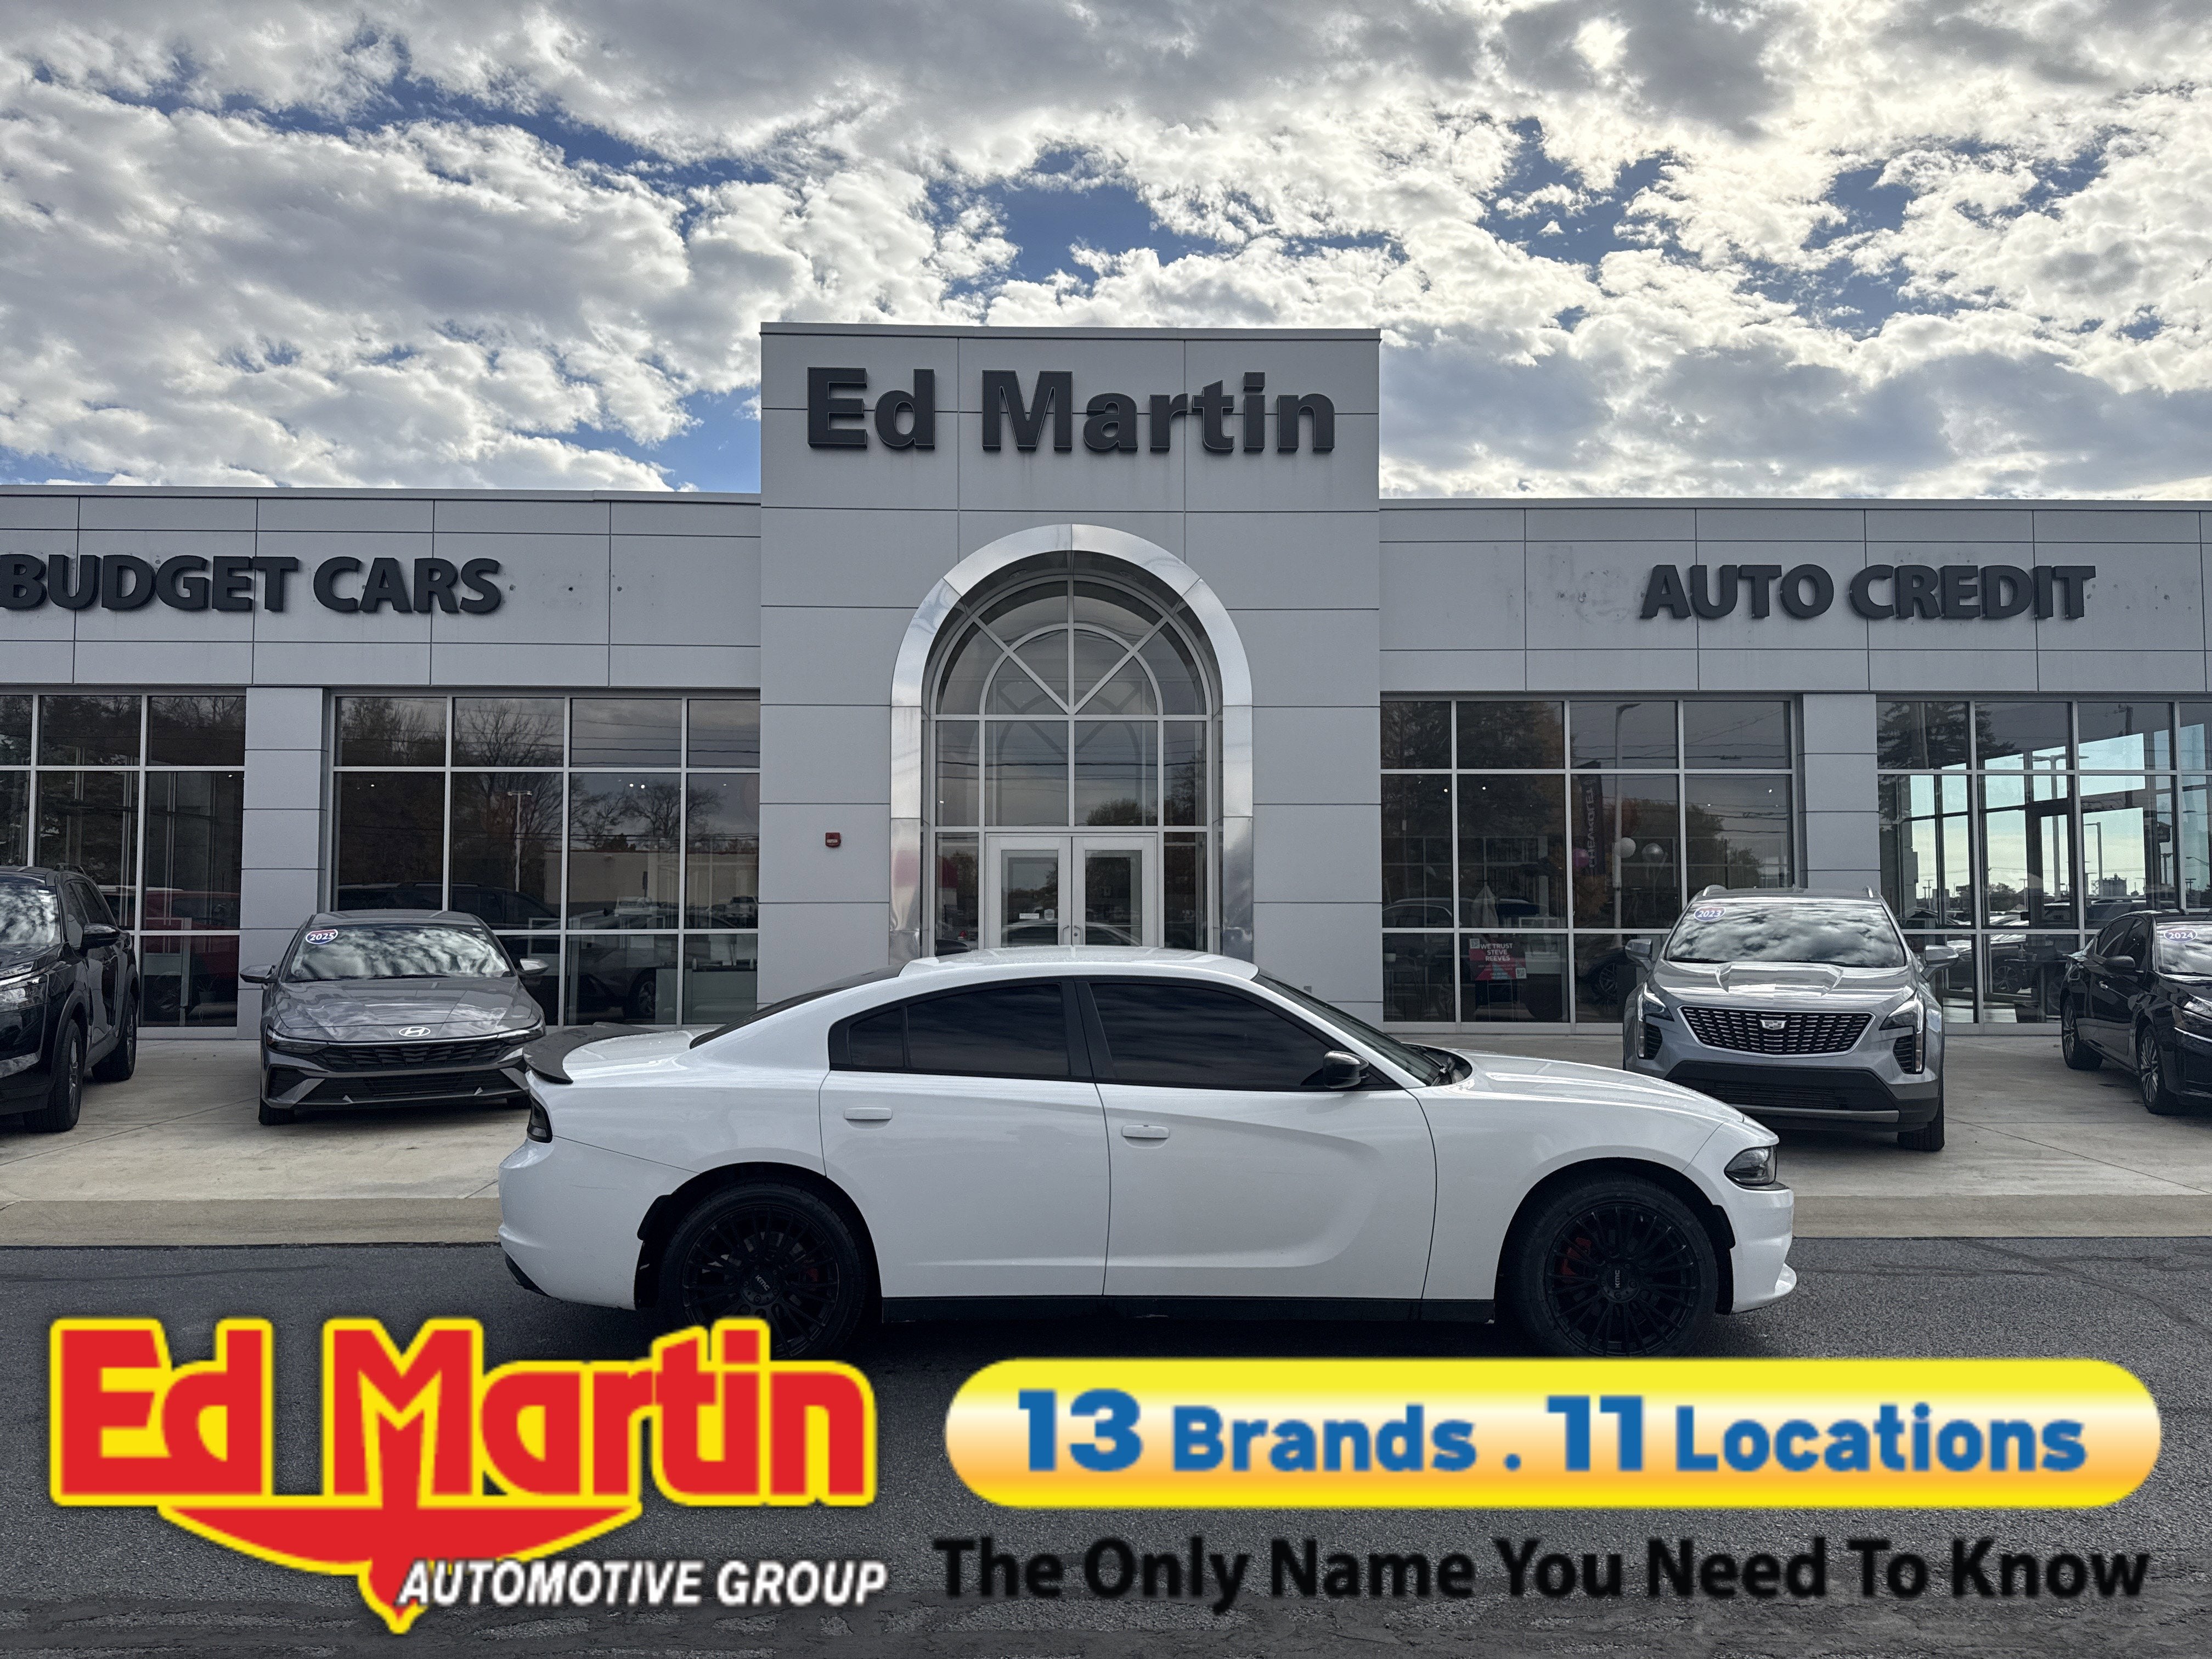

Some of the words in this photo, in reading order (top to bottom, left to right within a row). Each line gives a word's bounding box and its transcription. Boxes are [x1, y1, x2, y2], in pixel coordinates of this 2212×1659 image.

[808, 366, 935, 451] Ed
[981, 369, 1335, 453] Martin
[0, 554, 298, 612] BUDGET
[313, 556, 501, 613] CARS
[1639, 564, 1834, 620] AUTO
[1849, 564, 2096, 620] CREDIT
[309, 932, 335, 941] 2025
